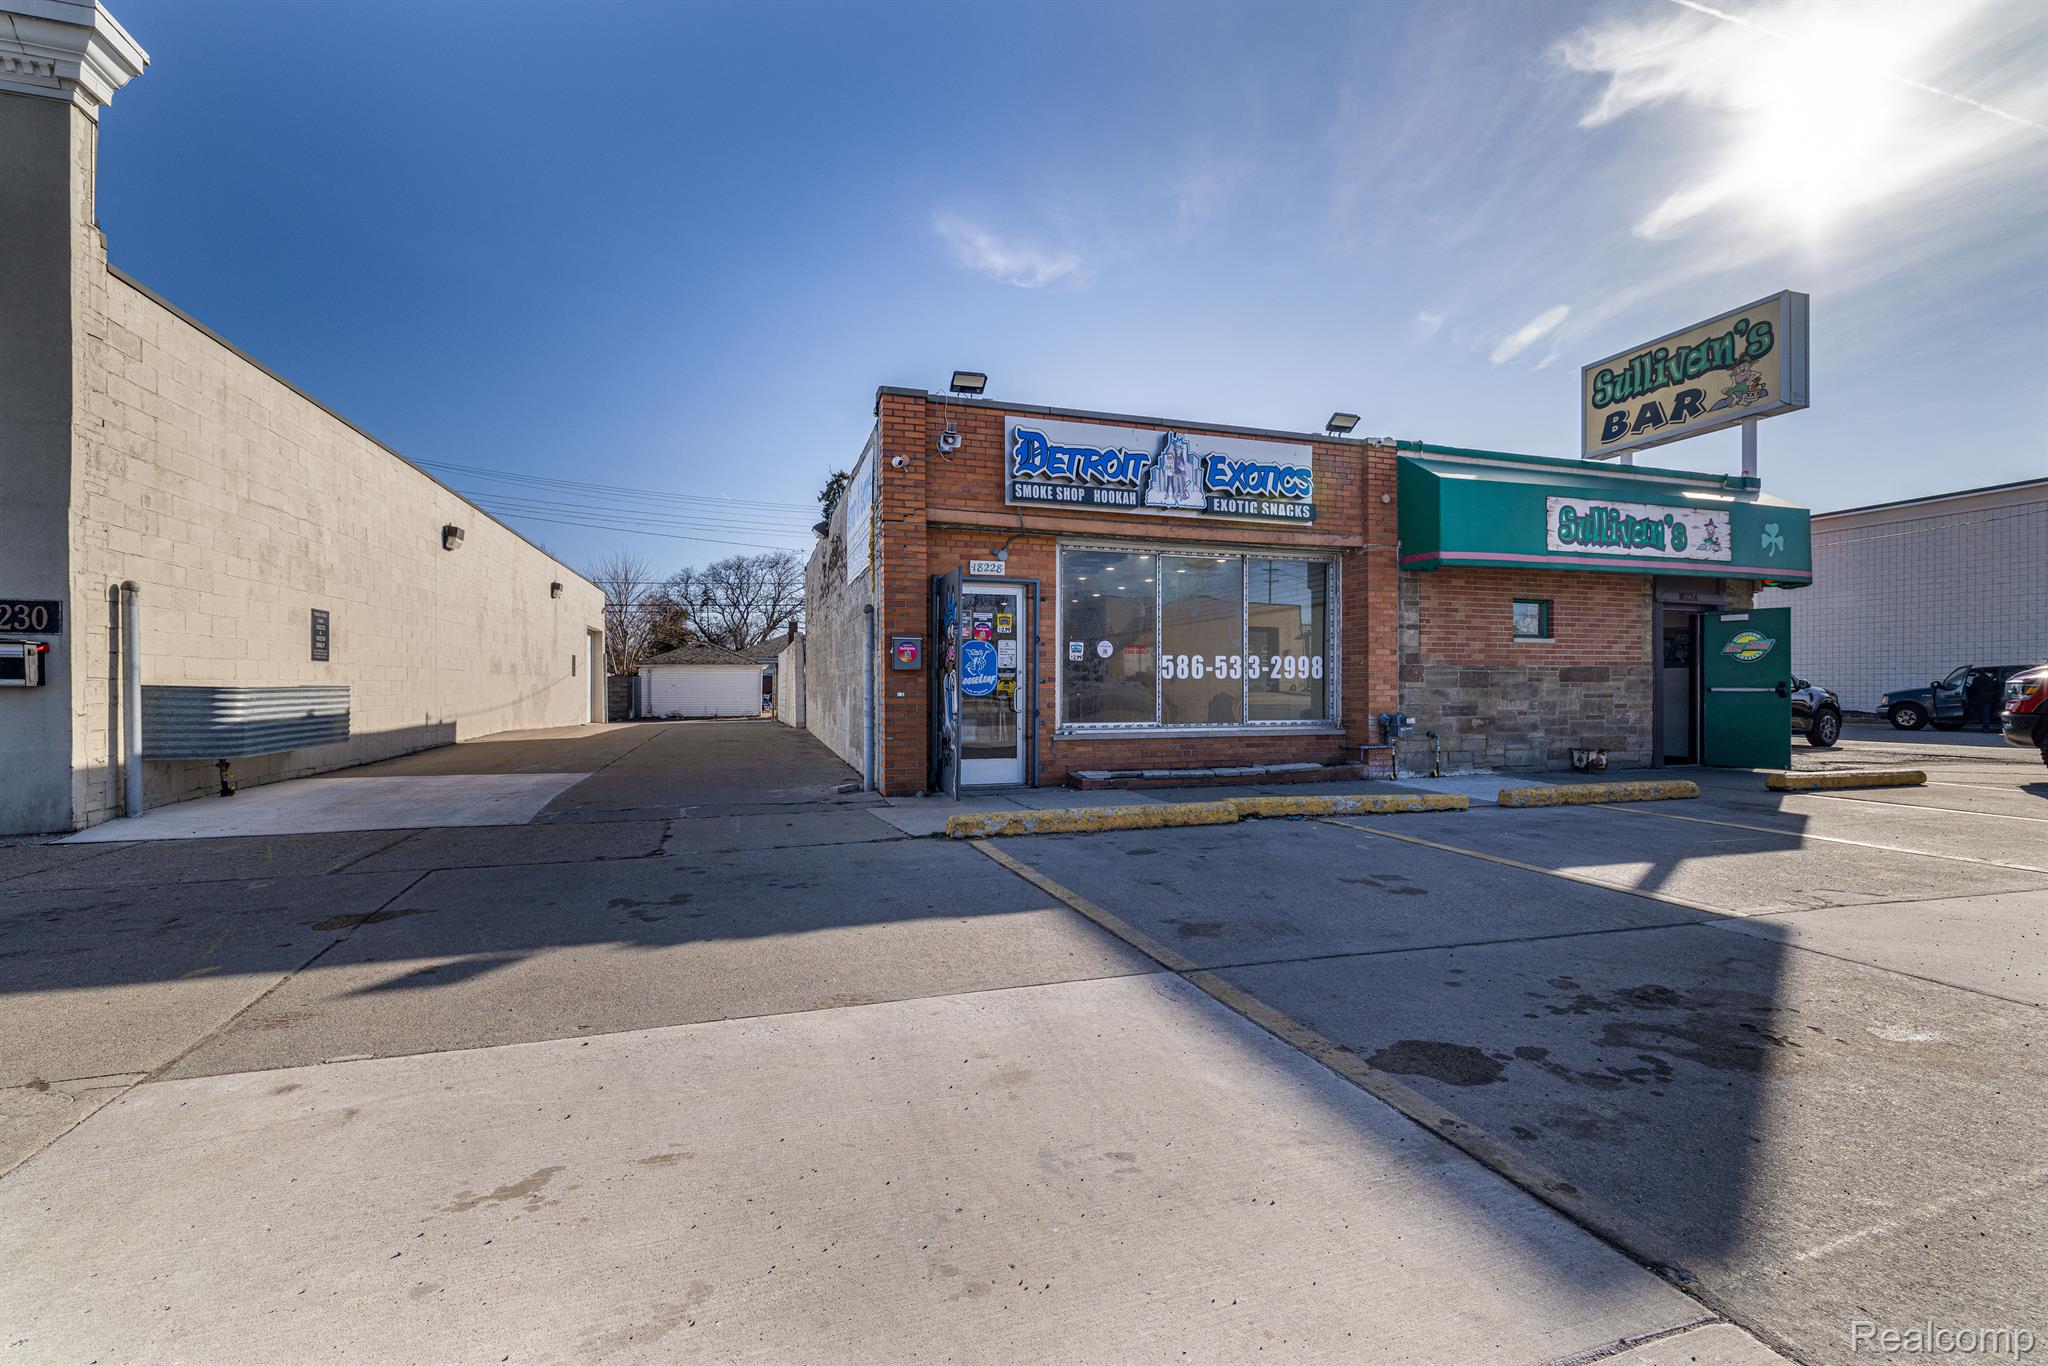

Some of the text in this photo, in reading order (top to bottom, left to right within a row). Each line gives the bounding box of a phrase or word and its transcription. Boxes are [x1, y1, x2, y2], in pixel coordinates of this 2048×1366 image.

[1592, 318, 1774, 409] Sullivan's
[1601, 388, 1707, 444] BAR
[1013, 425, 1313, 497] DETROIT EXOTICS
[1015, 484, 1311, 518] SMOKE SHOP HOOKAH EXOTIC SNACKS
[1558, 505, 1688, 553] Sullivan's
[971, 562, 1003, 574] 18228
[0, 604, 49, 630] 230
[962, 673, 997, 685] OOSELEAF
[1162, 655, 1323, 679] 586-533-2998
